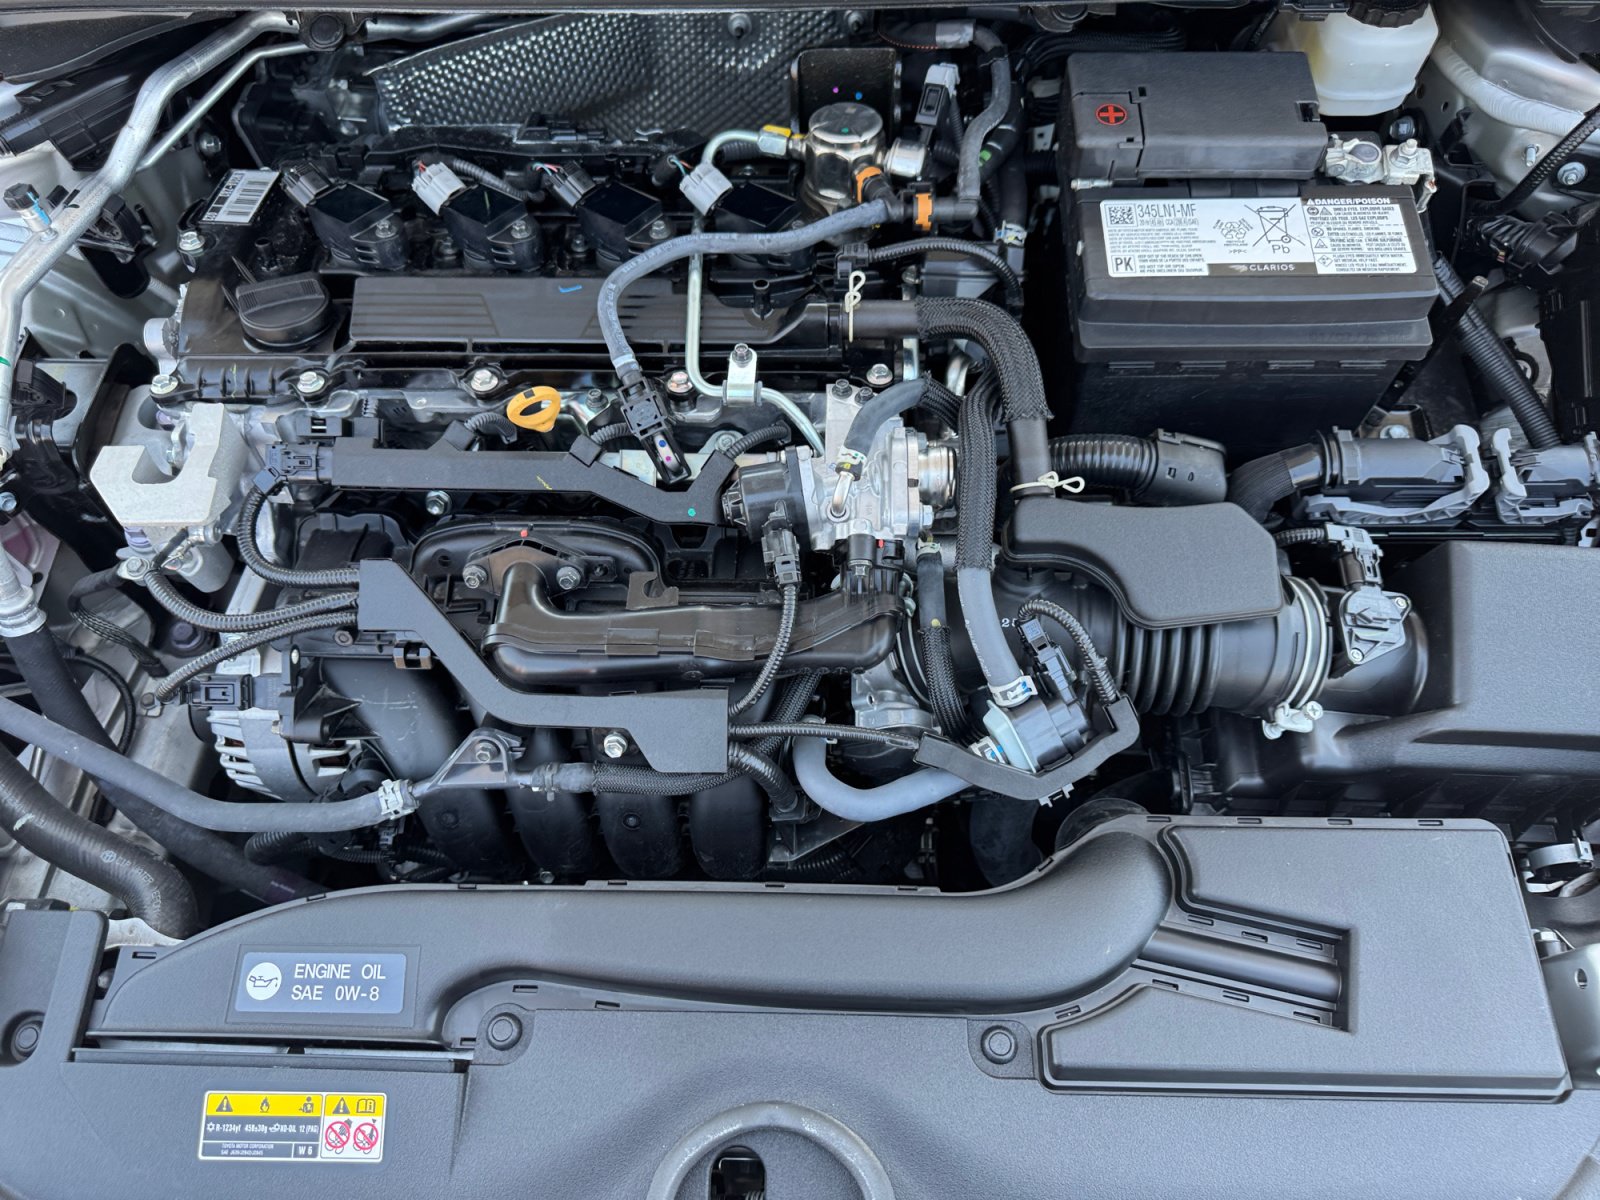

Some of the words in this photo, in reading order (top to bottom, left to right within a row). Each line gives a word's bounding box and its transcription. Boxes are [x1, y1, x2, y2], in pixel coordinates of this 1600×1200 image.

[1137, 203, 1197, 218] 345LN1-MF
[1271, 244, 1290, 254] Pb
[1115, 257, 1133, 272] PK
[294, 963, 351, 979] ENGINE
[361, 963, 386, 980] OIL
[291, 984, 324, 1001] SAE
[335, 985, 380, 1001] 0W-8
[215, 1123, 241, 1134] R-1234yf
[298, 1145, 306, 1155] W
